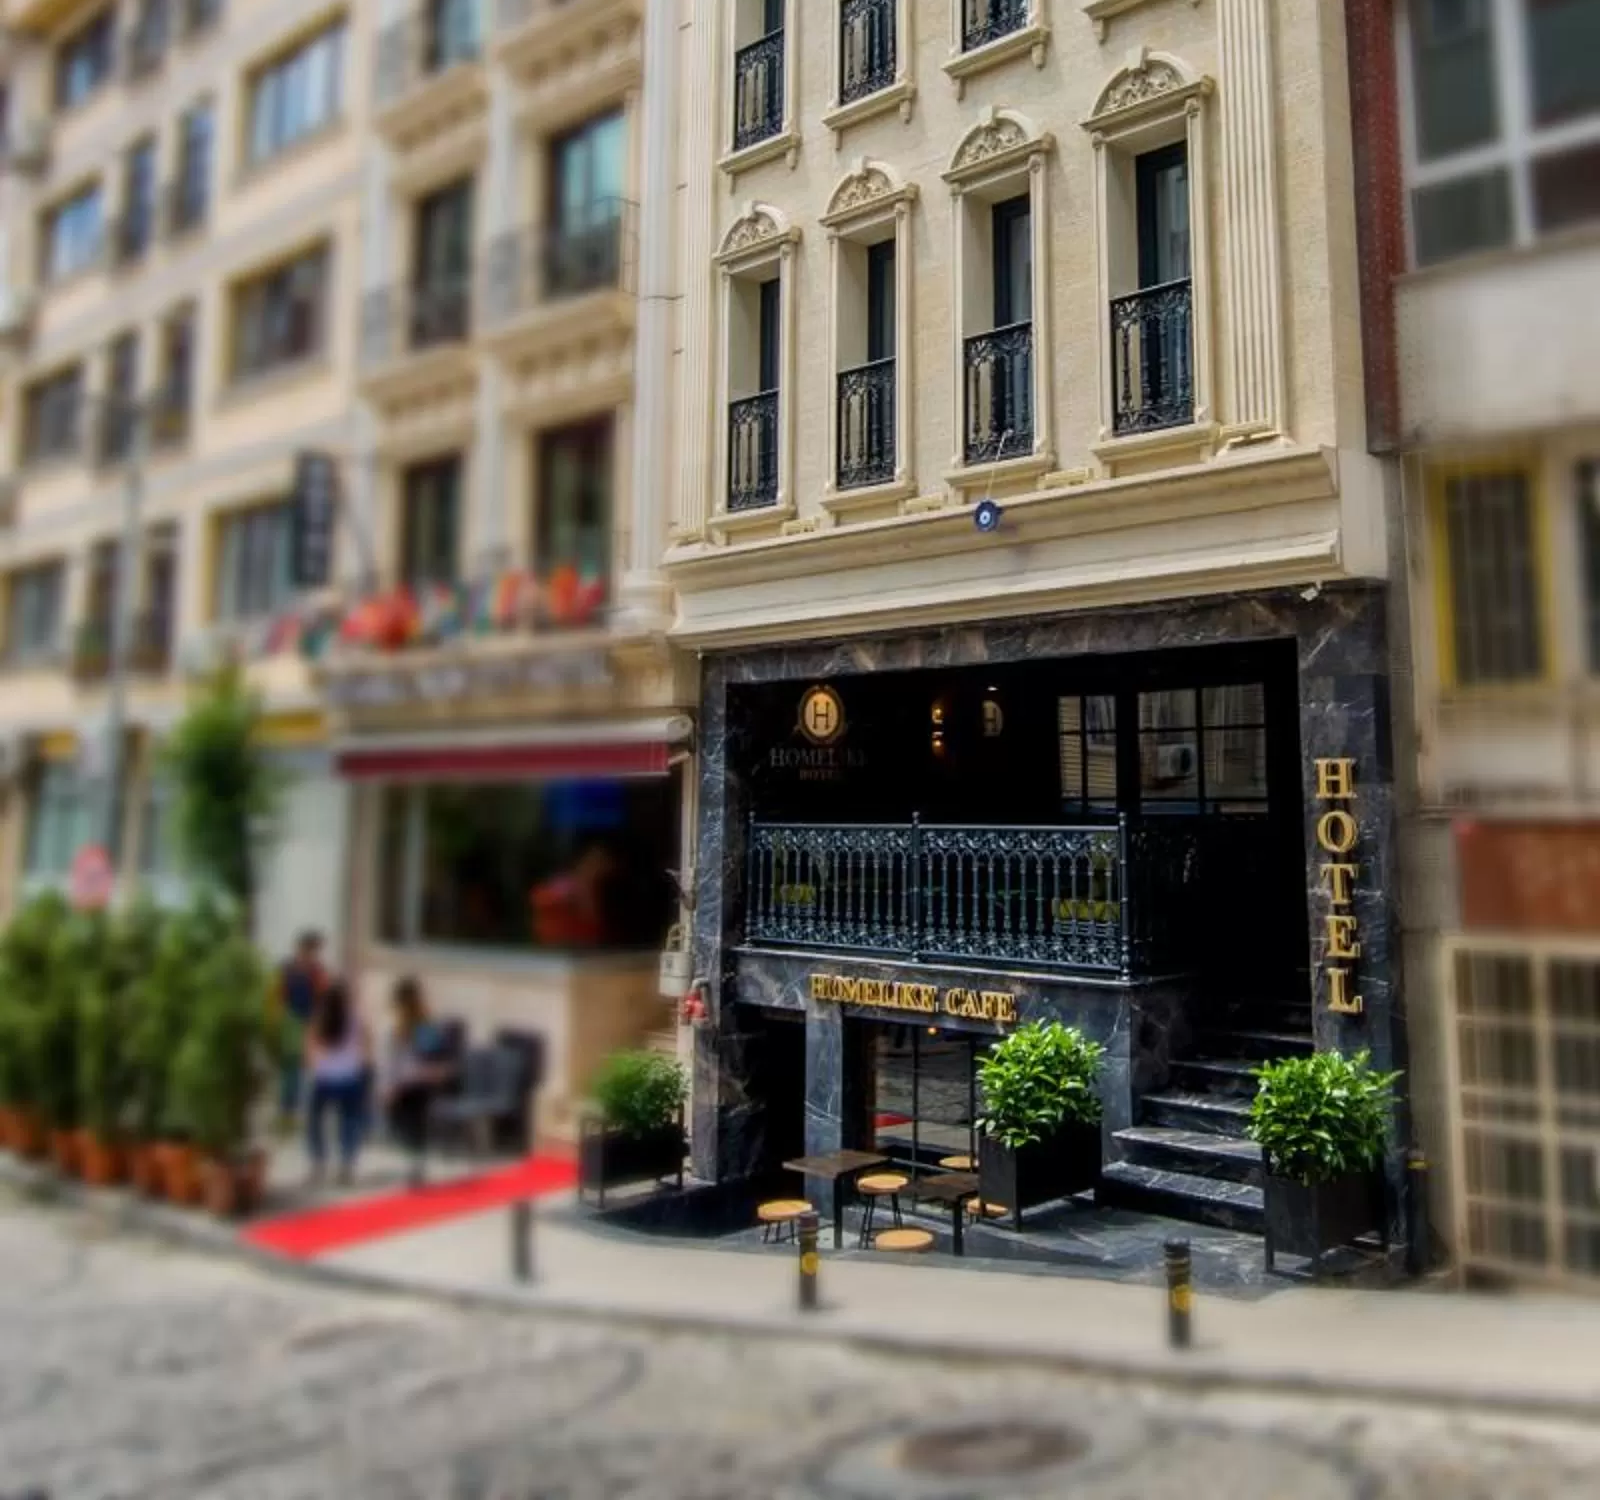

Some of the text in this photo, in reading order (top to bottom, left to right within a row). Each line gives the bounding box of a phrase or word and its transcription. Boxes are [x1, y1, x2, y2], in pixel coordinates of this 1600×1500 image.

[812, 700, 831, 731] H
[769, 747, 867, 768] HOMELK
[1314, 757, 1363, 1013] HOTEL
[811, 973, 1016, 1021] HOMELIKE CAFE
